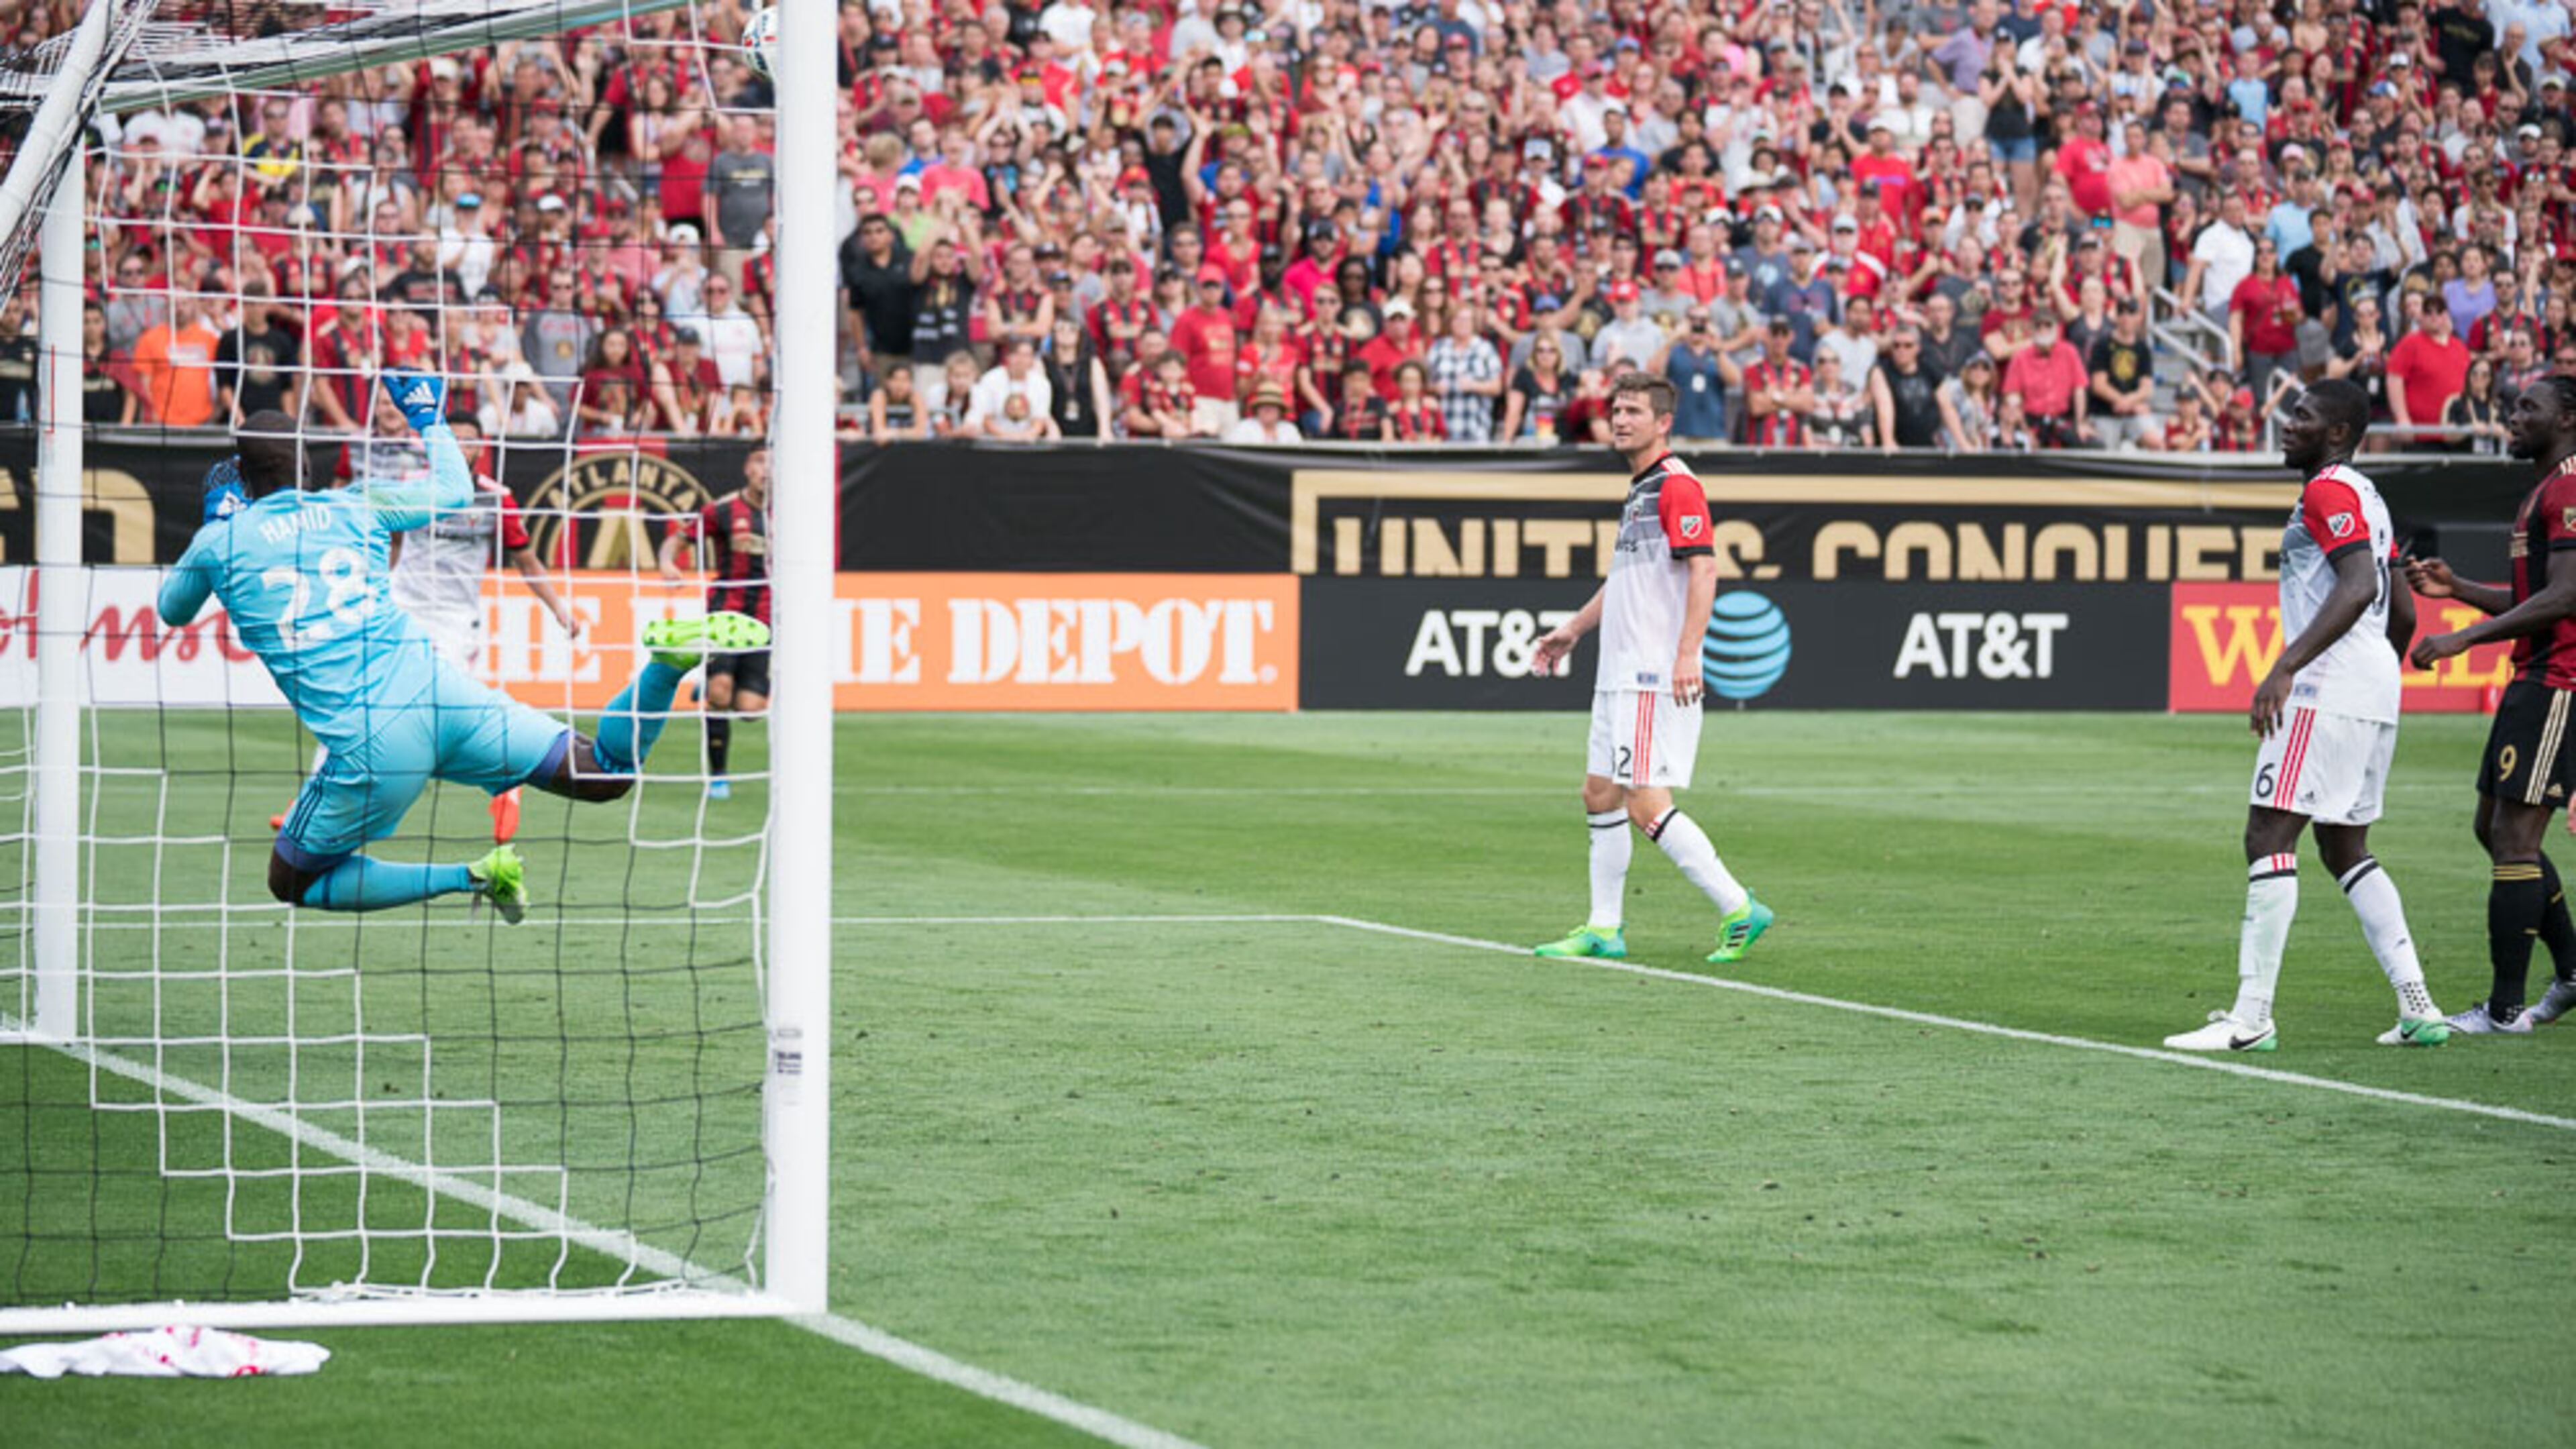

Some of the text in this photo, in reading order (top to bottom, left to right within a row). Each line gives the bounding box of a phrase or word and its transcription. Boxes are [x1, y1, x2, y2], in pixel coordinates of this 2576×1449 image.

[547, 458, 697, 513] ATLANTA
[258, 504, 331, 543] HAMID
[260, 545, 380, 653] 28
[478, 596, 601, 682] HE
[1893, 611, 2069, 679] AT&T
[2255, 763, 2275, 798] 6
[2500, 744, 2517, 782] 9
